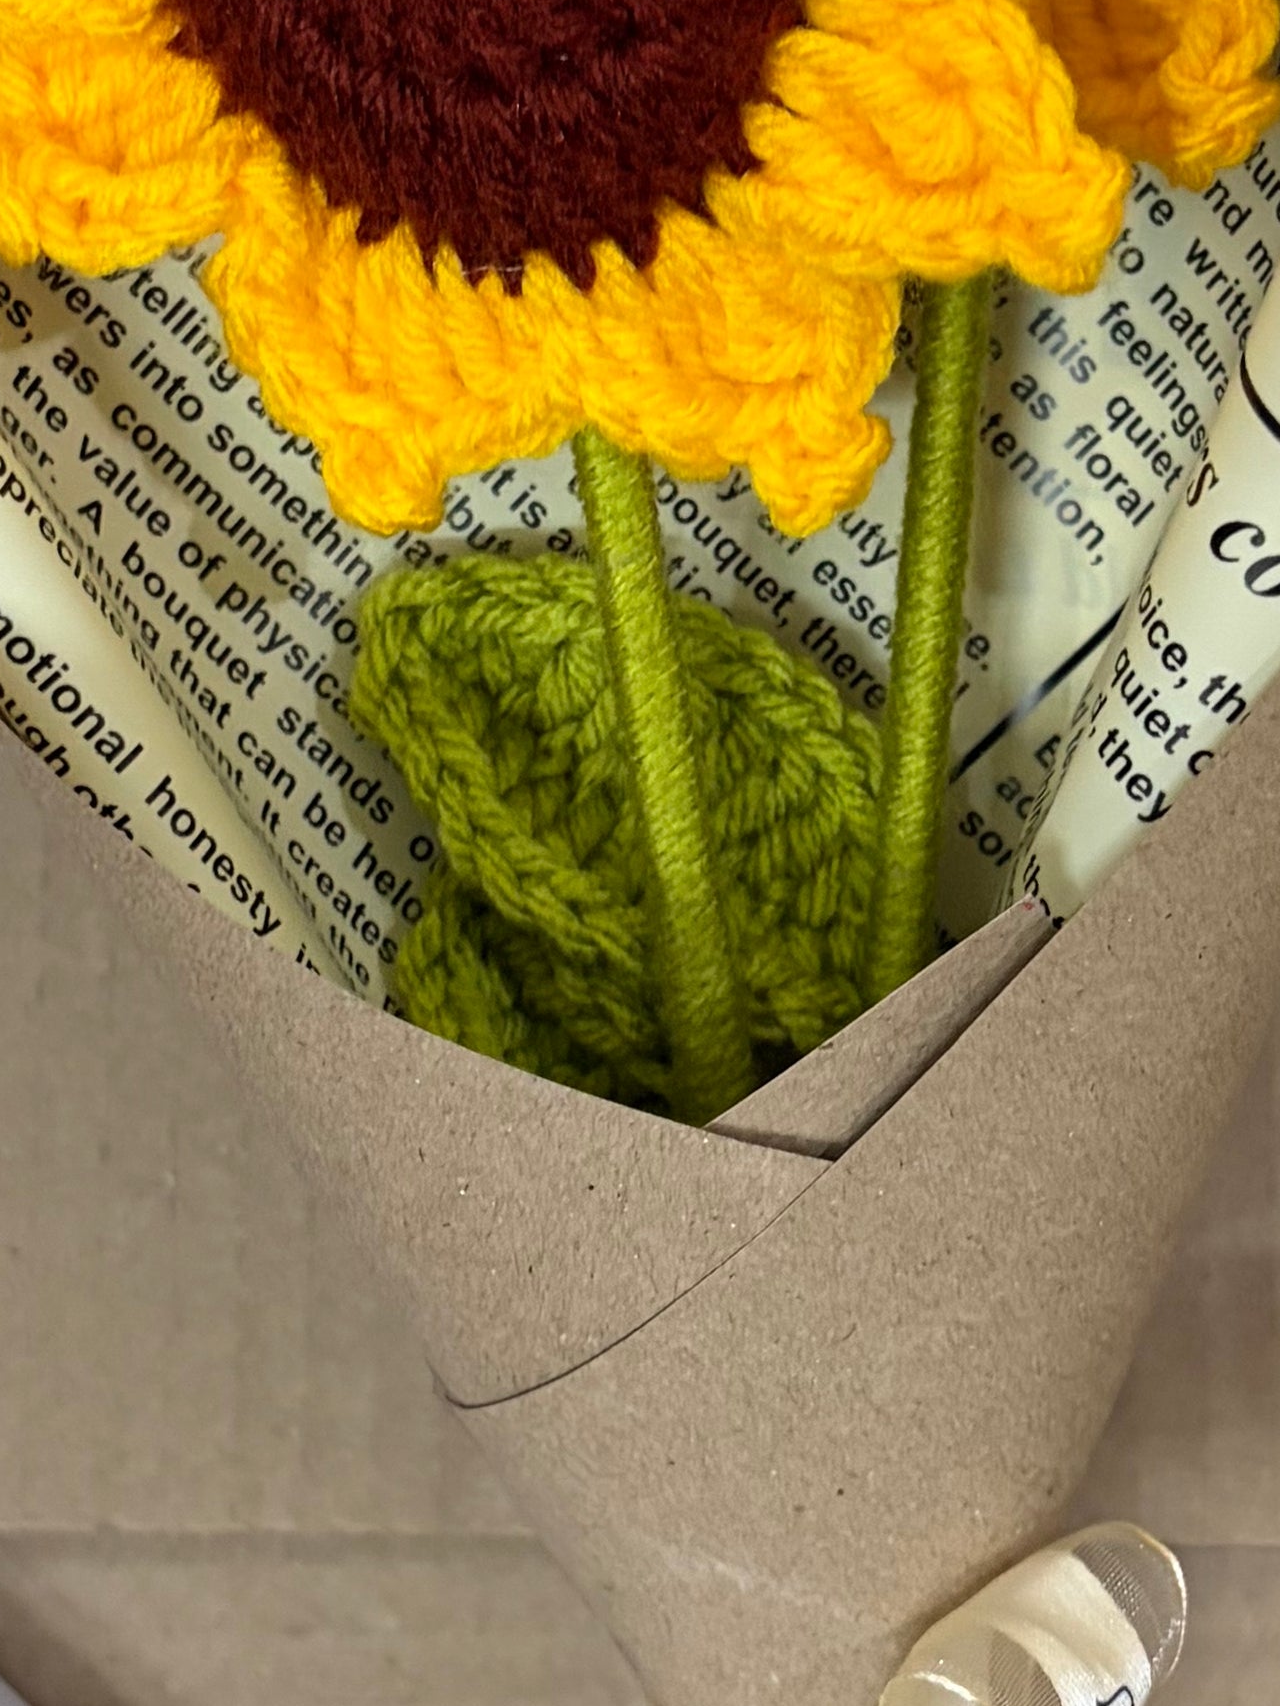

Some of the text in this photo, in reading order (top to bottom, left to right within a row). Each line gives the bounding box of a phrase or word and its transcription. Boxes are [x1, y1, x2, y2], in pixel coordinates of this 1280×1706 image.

[1202, 179, 1253, 236] nd
[12, 365, 69, 433] the
[78, 433, 172, 537] value
[178, 541, 227, 584] of
[37, 251, 128, 350] wers
[129, 341, 205, 423] into
[207, 422, 374, 588] somethin
[1010, 374, 1156, 528] as floral
[1027, 307, 1185, 494] this quiet
[53, 345, 100, 396] as
[111, 402, 362, 655] communicatio
[509, 483, 548, 530] is
[77, 499, 105, 536] A
[122, 540, 269, 701] bouquet
[277, 706, 396, 825] stands
[798, 616, 887, 711] there
[1110, 647, 1192, 755] quiet
[170, 649, 232, 731] that
[238, 730, 298, 800] can
[303, 794, 346, 847] be
[1097, 727, 1174, 824] they
[144, 775, 282, 938] honesty
[287, 839, 399, 965] creates
